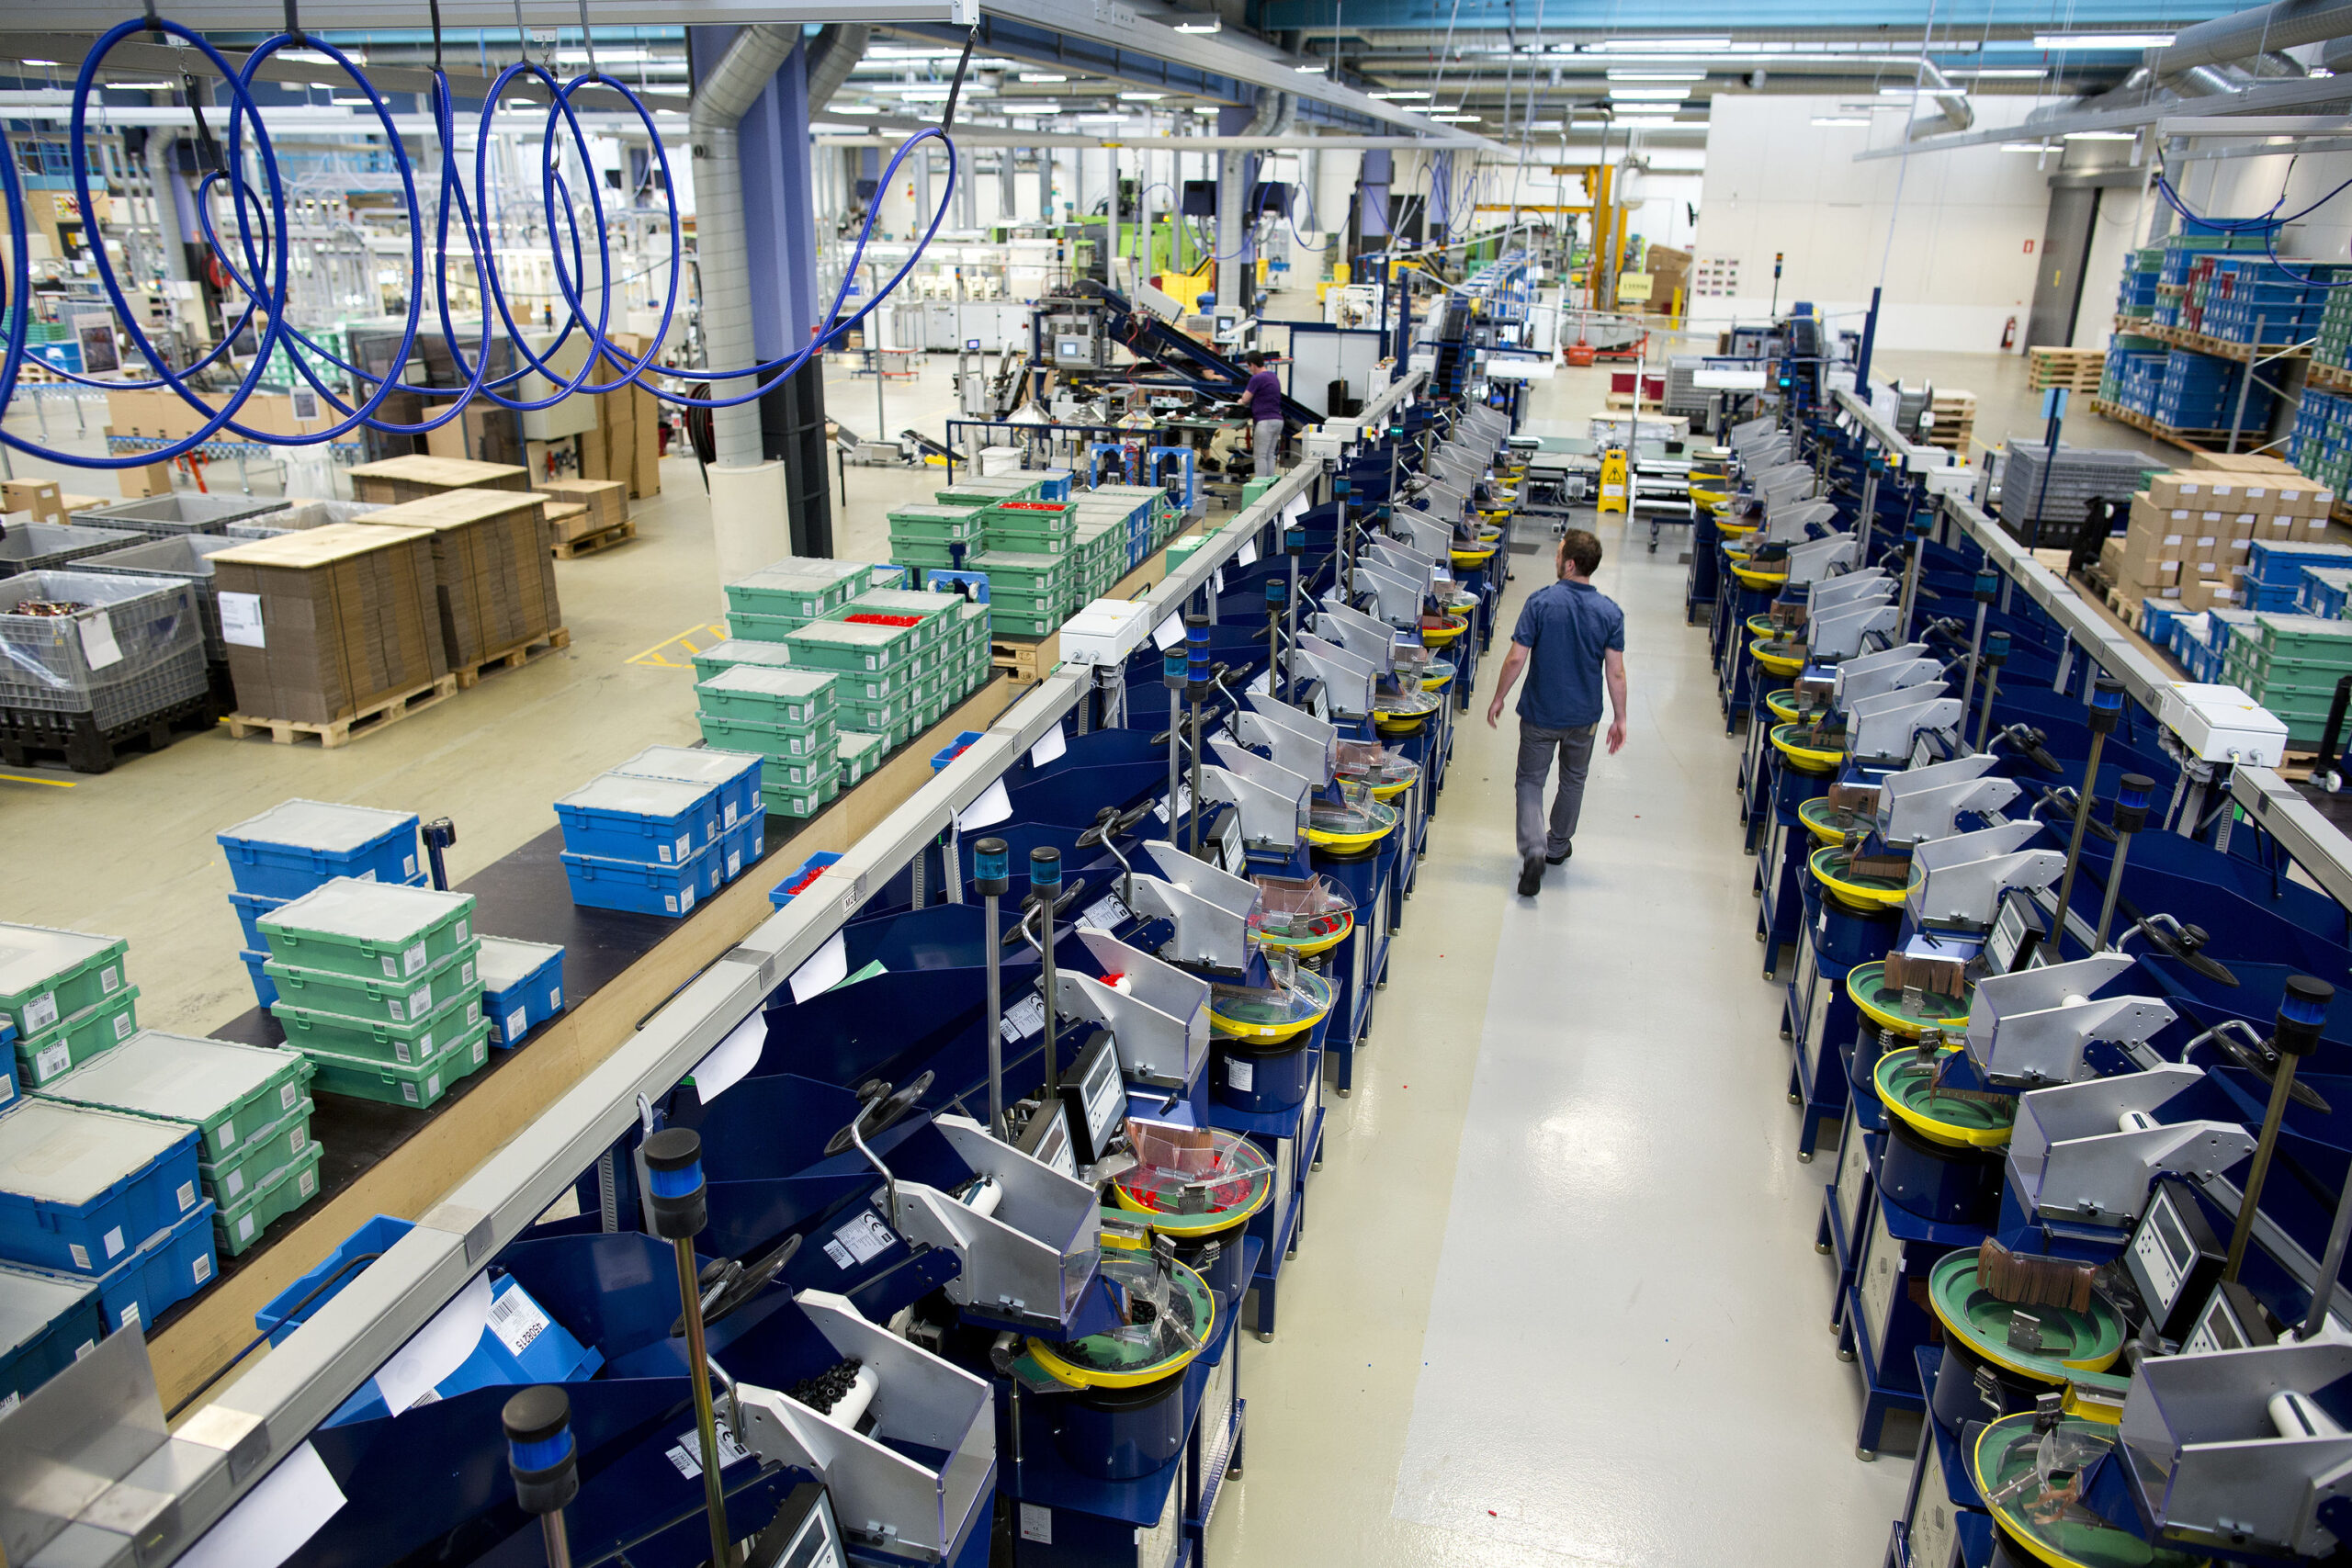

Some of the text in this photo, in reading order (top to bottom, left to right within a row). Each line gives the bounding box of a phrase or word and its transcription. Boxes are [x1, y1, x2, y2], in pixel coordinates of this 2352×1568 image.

[1108, 895, 1121, 909] CE
[865, 1213, 883, 1233] CE
[515, 1322, 543, 1350] 4508215
[714, 1421, 734, 1442] CE
